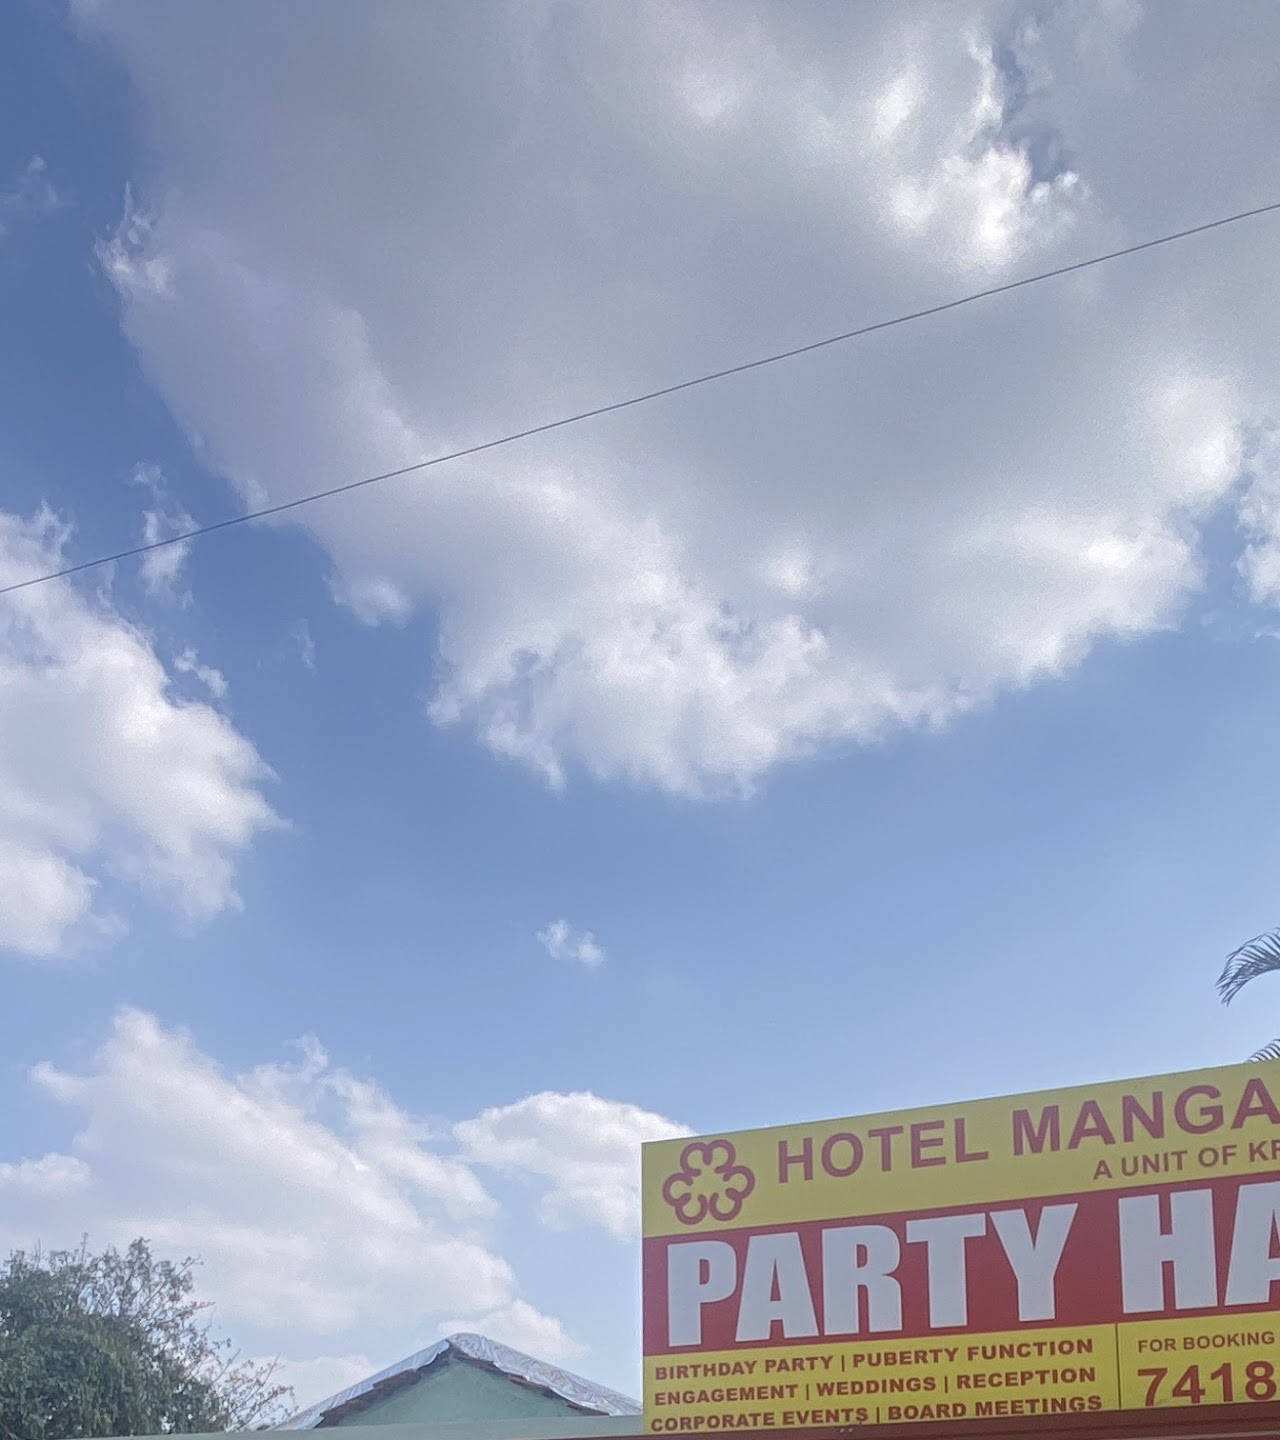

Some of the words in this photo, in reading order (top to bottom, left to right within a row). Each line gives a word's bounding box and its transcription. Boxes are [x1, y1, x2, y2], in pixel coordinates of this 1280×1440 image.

[778, 1117, 989, 1183] HOTEL
[1092, 1160, 1113, 1181] A
[1121, 1150, 1188, 1176] UNIT
[1198, 1144, 1237, 1168] OF
[667, 1203, 1078, 1347] PARTY
[655, 1360, 757, 1381] BIRTHDAY
[765, 1355, 833, 1373] PARTY
[853, 1347, 959, 1368] PUBERTY
[967, 1338, 1093, 1361] FUNCTION
[1138, 1338, 1177, 1353] FOR
[1183, 1329, 1275, 1350] BOOKING
[655, 1384, 798, 1406] ENGAGEMENT
[816, 1377, 936, 1396] WEDDINGS
[956, 1367, 1095, 1389] RECEPTION
[651, 1412, 775, 1432] CORPORATE
[782, 1407, 868, 1425] EVENTS
[888, 1402, 966, 1420] BOARD
[975, 1395, 1102, 1417] MEETINGS
